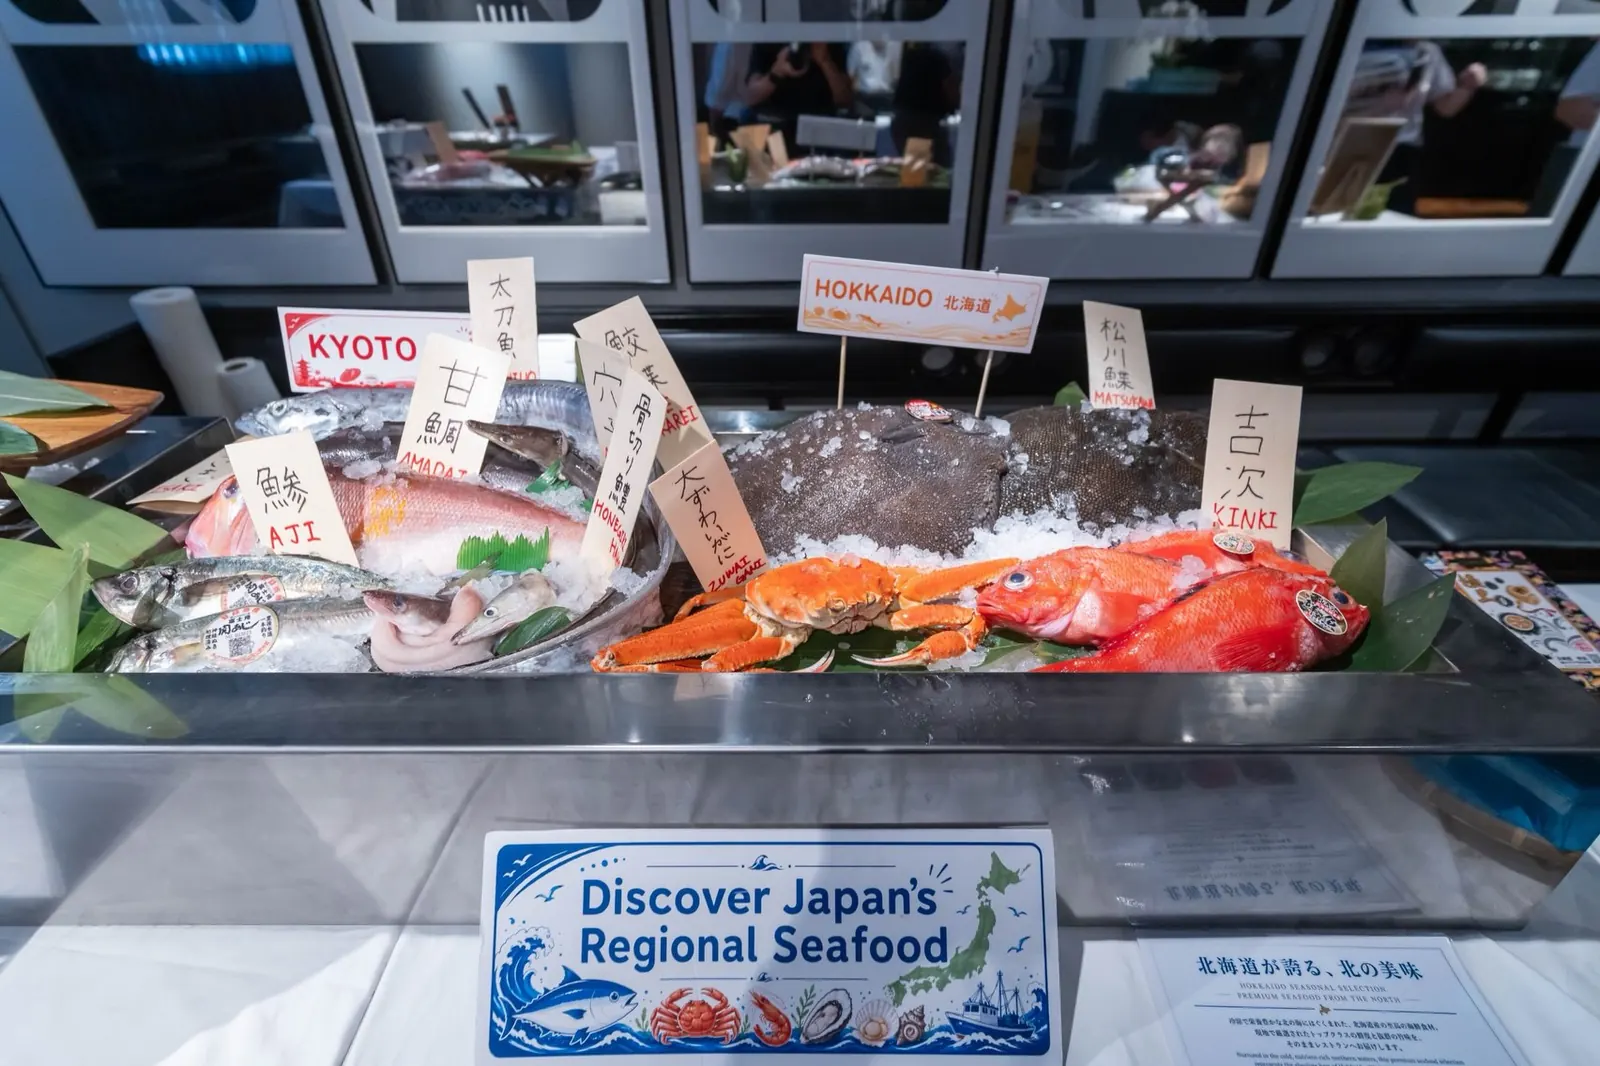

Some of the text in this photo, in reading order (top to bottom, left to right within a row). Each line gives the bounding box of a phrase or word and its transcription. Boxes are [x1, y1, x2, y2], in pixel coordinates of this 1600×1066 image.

[815, 278, 992, 314] HOKKAIDO 北海道
[489, 273, 516, 359] 太刀魚
[308, 333, 417, 362] KYOTO
[416, 359, 488, 454] 甘鯛
[1220, 405, 1269, 500] 吉次
[1212, 502, 1278, 530] KINKI
[269, 520, 322, 550] AJI
[708, 555, 751, 592] ZUWAI
[581, 877, 938, 924] Discover Japan's
[580, 924, 949, 973] Regional Seafood
[1196, 956, 1423, 980] 北海道が誇る、北の美味
[1236, 992, 1401, 1004] PREMIUM SEAFOOD FROM THE NORTH
[1239, 982, 1387, 992] HOKKAIDO SEASONAL SELECTION
